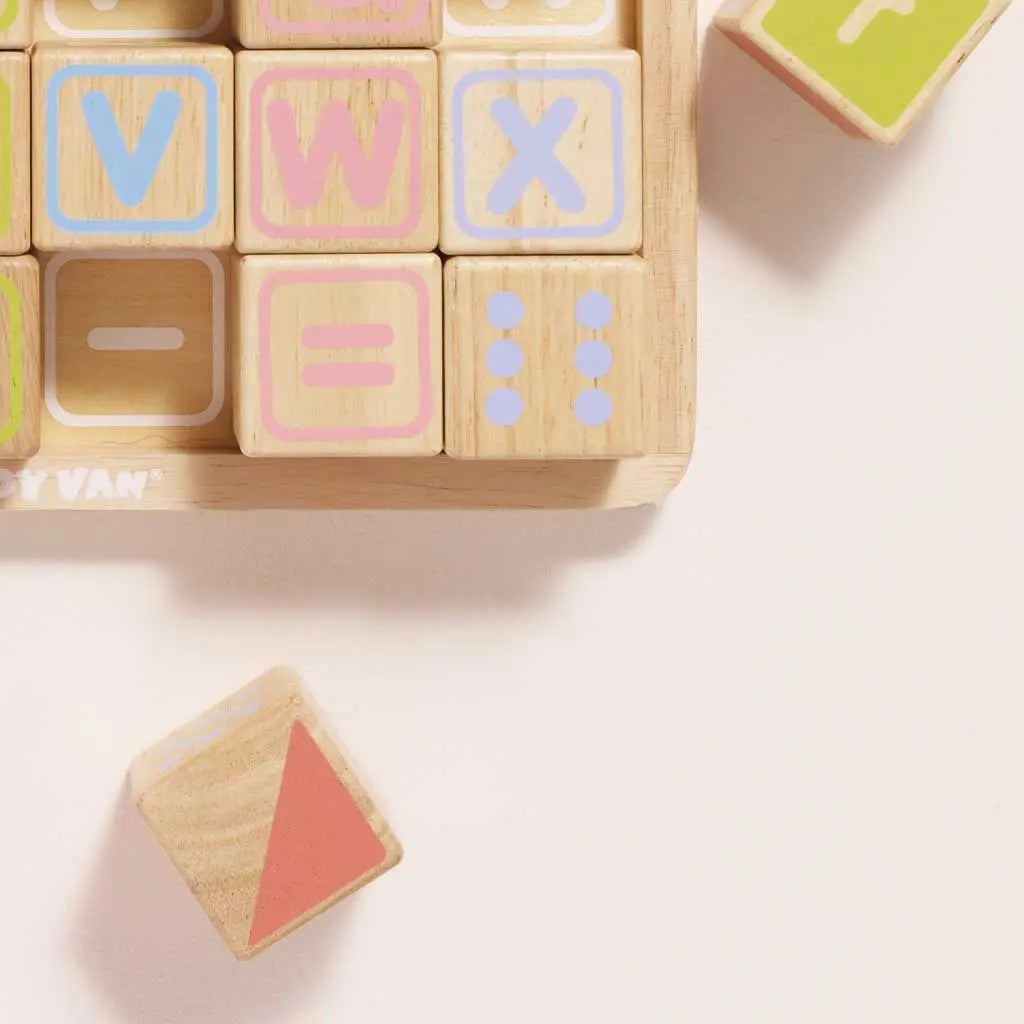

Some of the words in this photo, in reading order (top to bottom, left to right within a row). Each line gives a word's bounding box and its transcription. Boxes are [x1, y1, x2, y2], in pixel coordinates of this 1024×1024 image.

[81, 90, 182, 207] V
[266, 98, 404, 209] W
[485, 96, 587, 214] X
